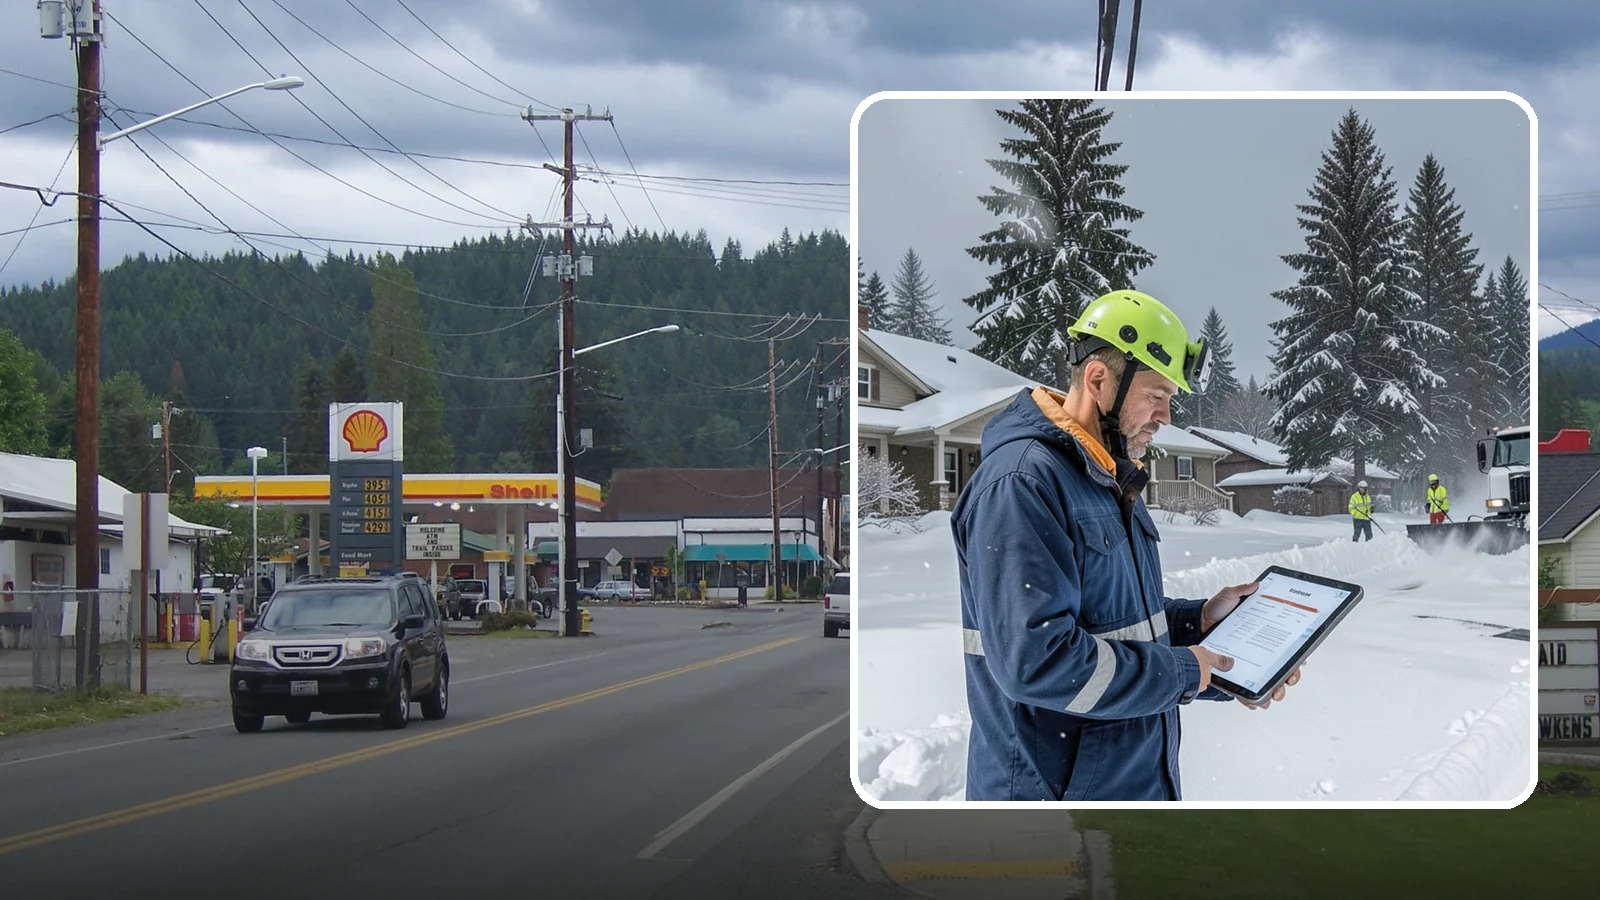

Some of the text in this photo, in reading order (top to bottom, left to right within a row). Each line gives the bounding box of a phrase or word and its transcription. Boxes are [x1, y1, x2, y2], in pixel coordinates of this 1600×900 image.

[366, 480, 383, 490] 395
[490, 484, 548, 499] Shell
[366, 494, 383, 504] 405
[366, 508, 383, 518] 415
[366, 522, 383, 533] 429
